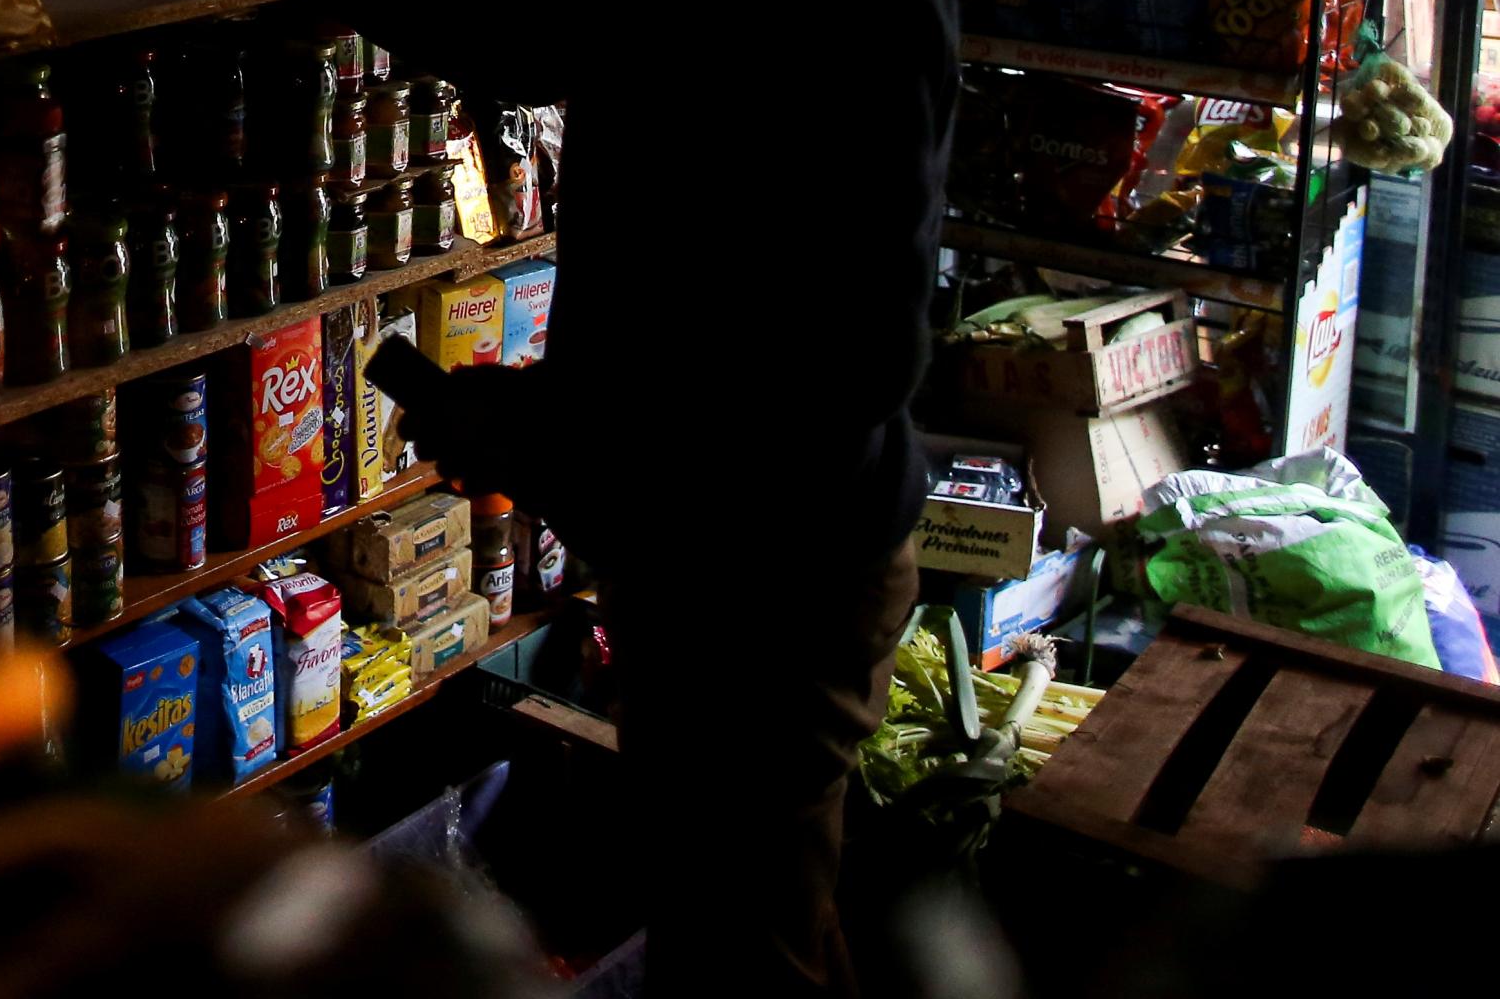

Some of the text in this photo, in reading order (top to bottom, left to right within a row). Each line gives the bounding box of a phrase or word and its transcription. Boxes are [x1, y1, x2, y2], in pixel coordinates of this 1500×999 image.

[1106, 61, 1168, 81] sabor
[513, 279, 552, 302] Hileret
[448, 296, 497, 321] Hileret
[1107, 330, 1187, 393] VICTOR
[261, 358, 318, 416] Rex
[276, 512, 299, 534] Rex
